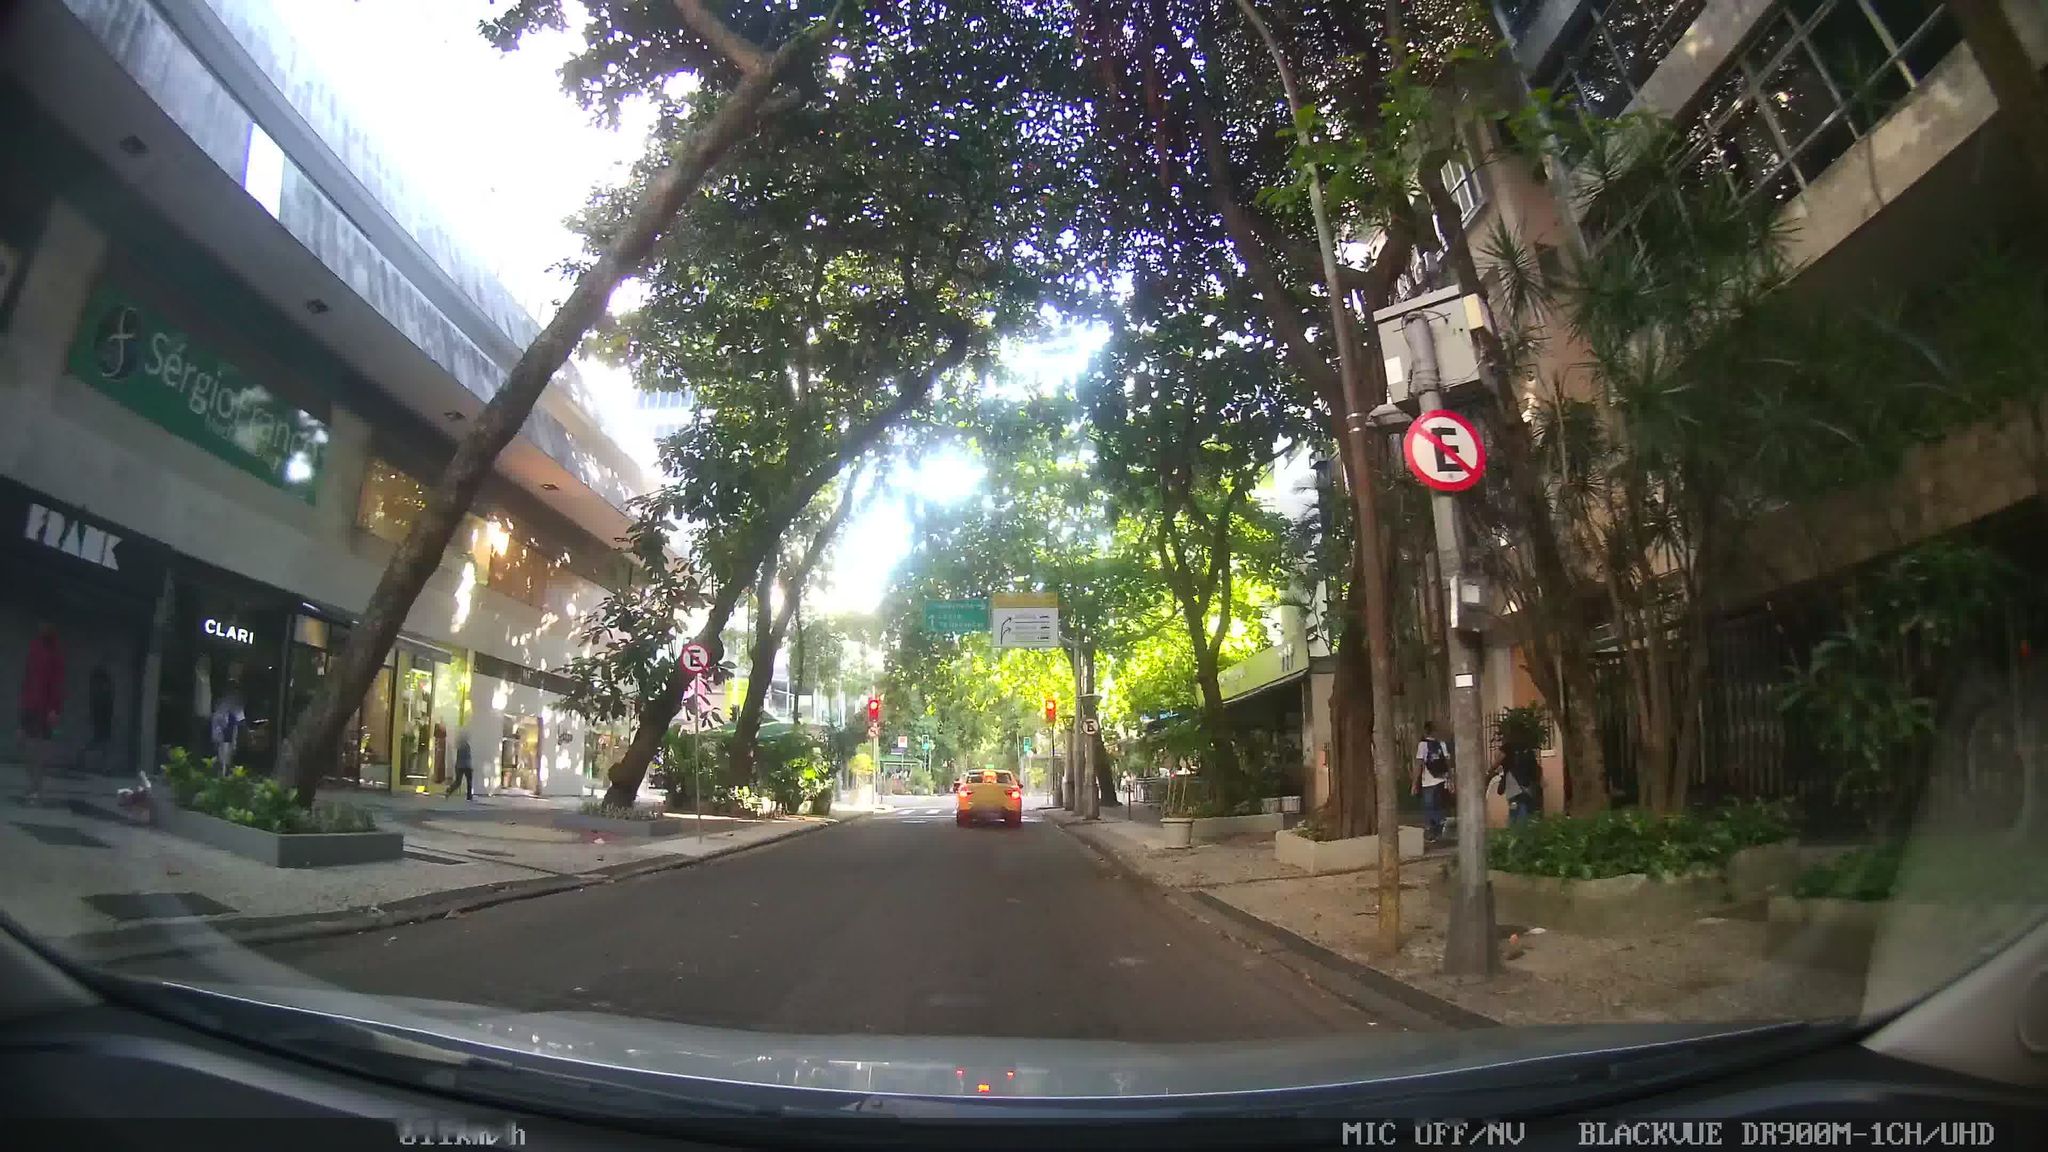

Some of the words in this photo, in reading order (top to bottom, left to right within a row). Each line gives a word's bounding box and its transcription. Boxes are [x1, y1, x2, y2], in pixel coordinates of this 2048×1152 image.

[144, 331, 235, 416] Sérgio
[1432, 427, 1463, 472] E
[25, 503, 123, 570] FRANK
[203, 618, 254, 645] CLARI
[689, 649, 701, 667] E
